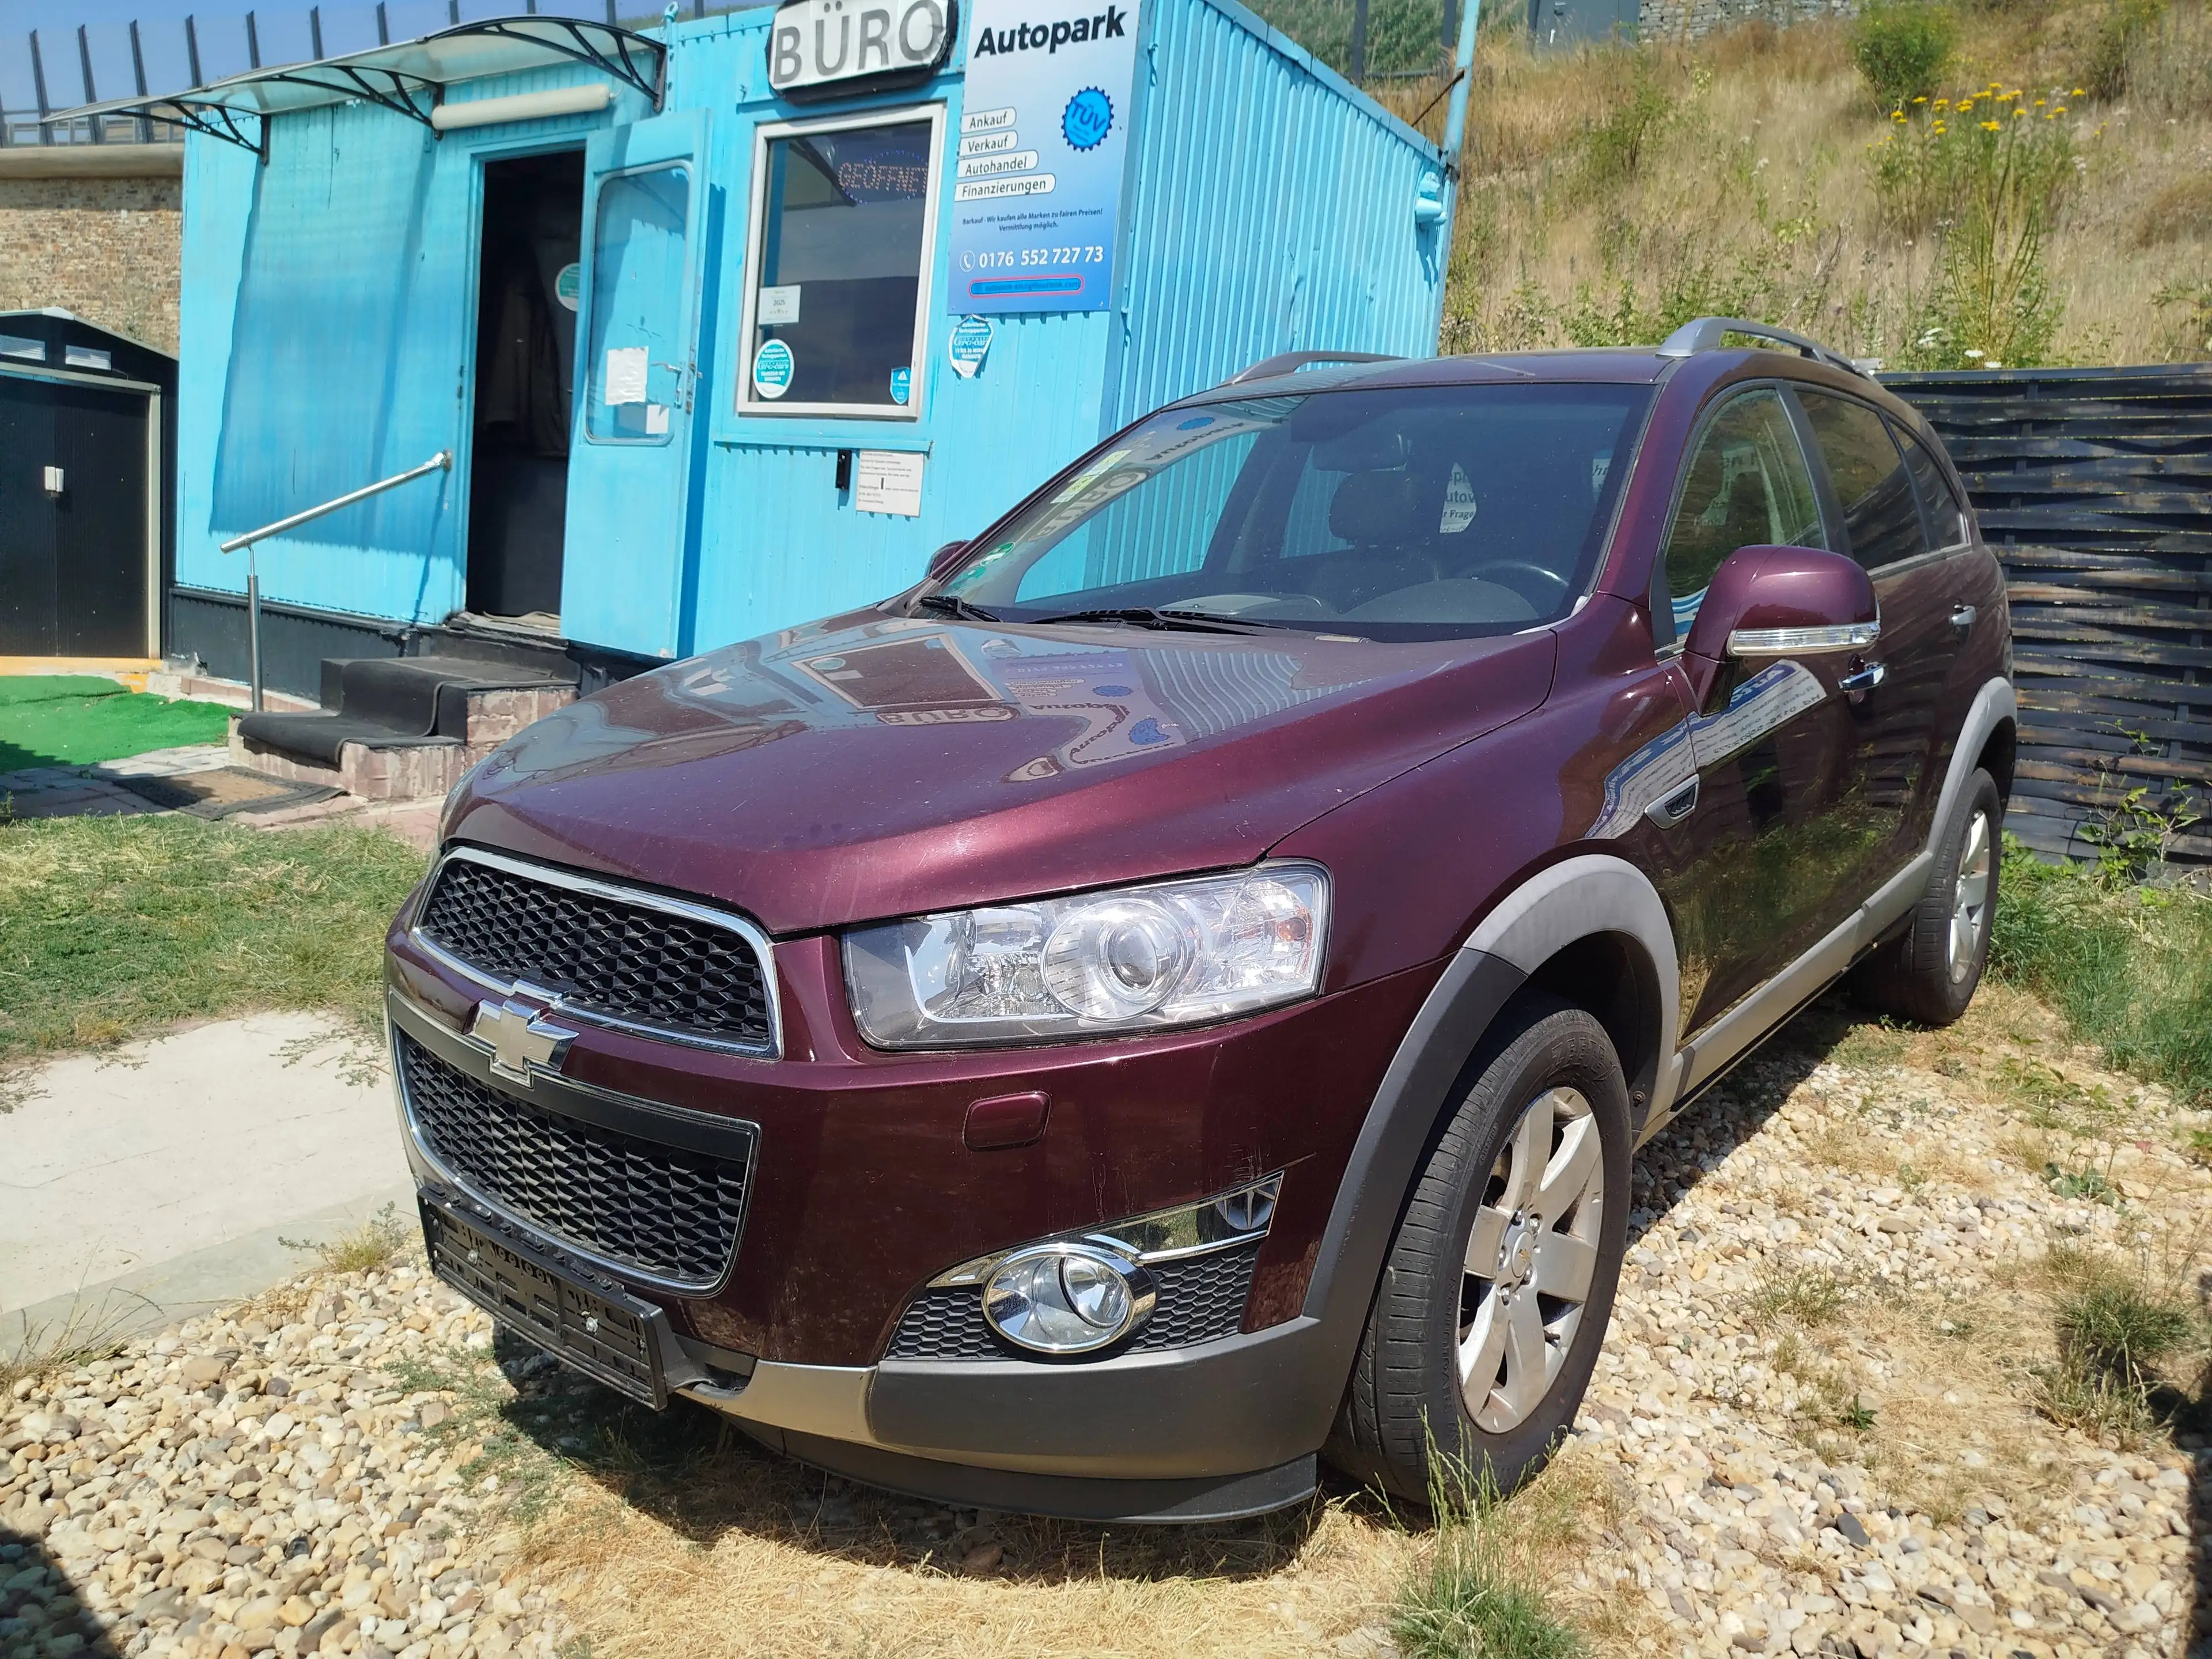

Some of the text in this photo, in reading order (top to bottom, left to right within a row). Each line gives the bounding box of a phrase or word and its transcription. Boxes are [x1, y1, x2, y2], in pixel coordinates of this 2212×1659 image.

[974, 5, 1128, 58] Autopark
[772, 0, 945, 84] BÜRO
[969, 111, 1007, 130] Ankauf
[968, 135, 1009, 153] Verkauf
[965, 156, 1027, 176] Autohandel
[962, 180, 1046, 197] Finanzierungen
[997, 214, 1016, 222] kaufen
[1028, 211, 1050, 219] Marken
[1059, 210, 1077, 218] fairen
[999, 221, 1032, 232] Vermittlung
[979, 245, 1104, 268] 0176 552 727 73
